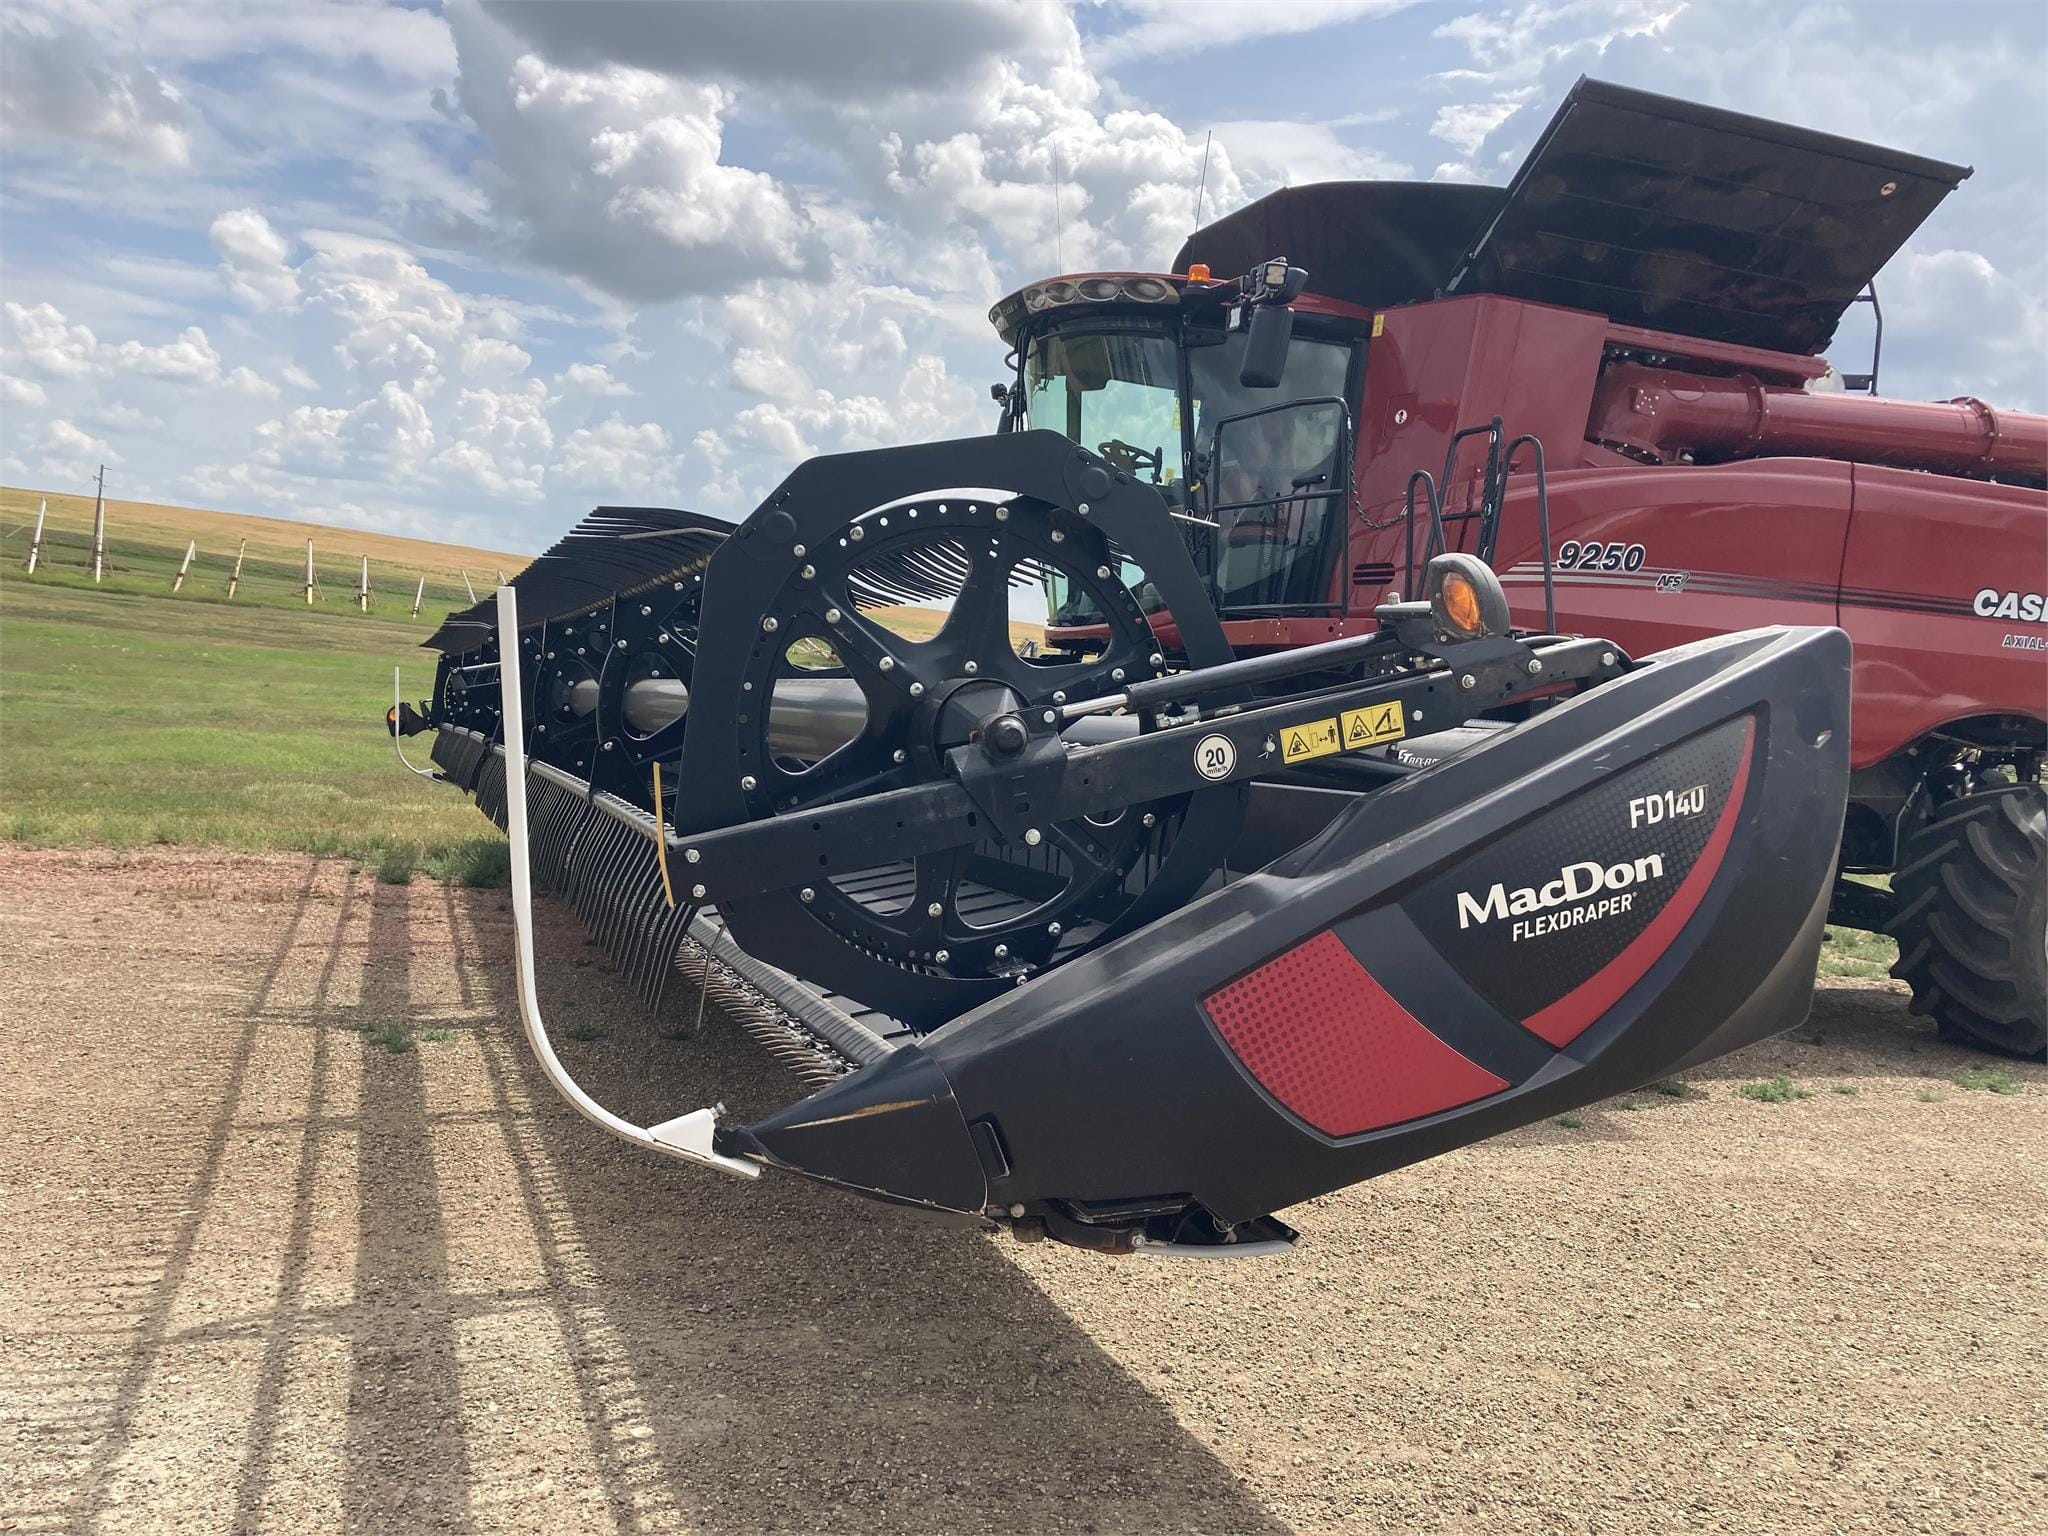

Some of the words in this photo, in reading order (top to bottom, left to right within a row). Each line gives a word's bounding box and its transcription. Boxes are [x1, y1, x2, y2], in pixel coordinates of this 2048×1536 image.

[1557, 541, 1646, 573] 9250
[1656, 573, 1683, 587] AFS
[1206, 747, 1225, 768] 20
[1456, 853, 1664, 930] MacDon
[1512, 893, 1633, 942] FLEXDRAPER
